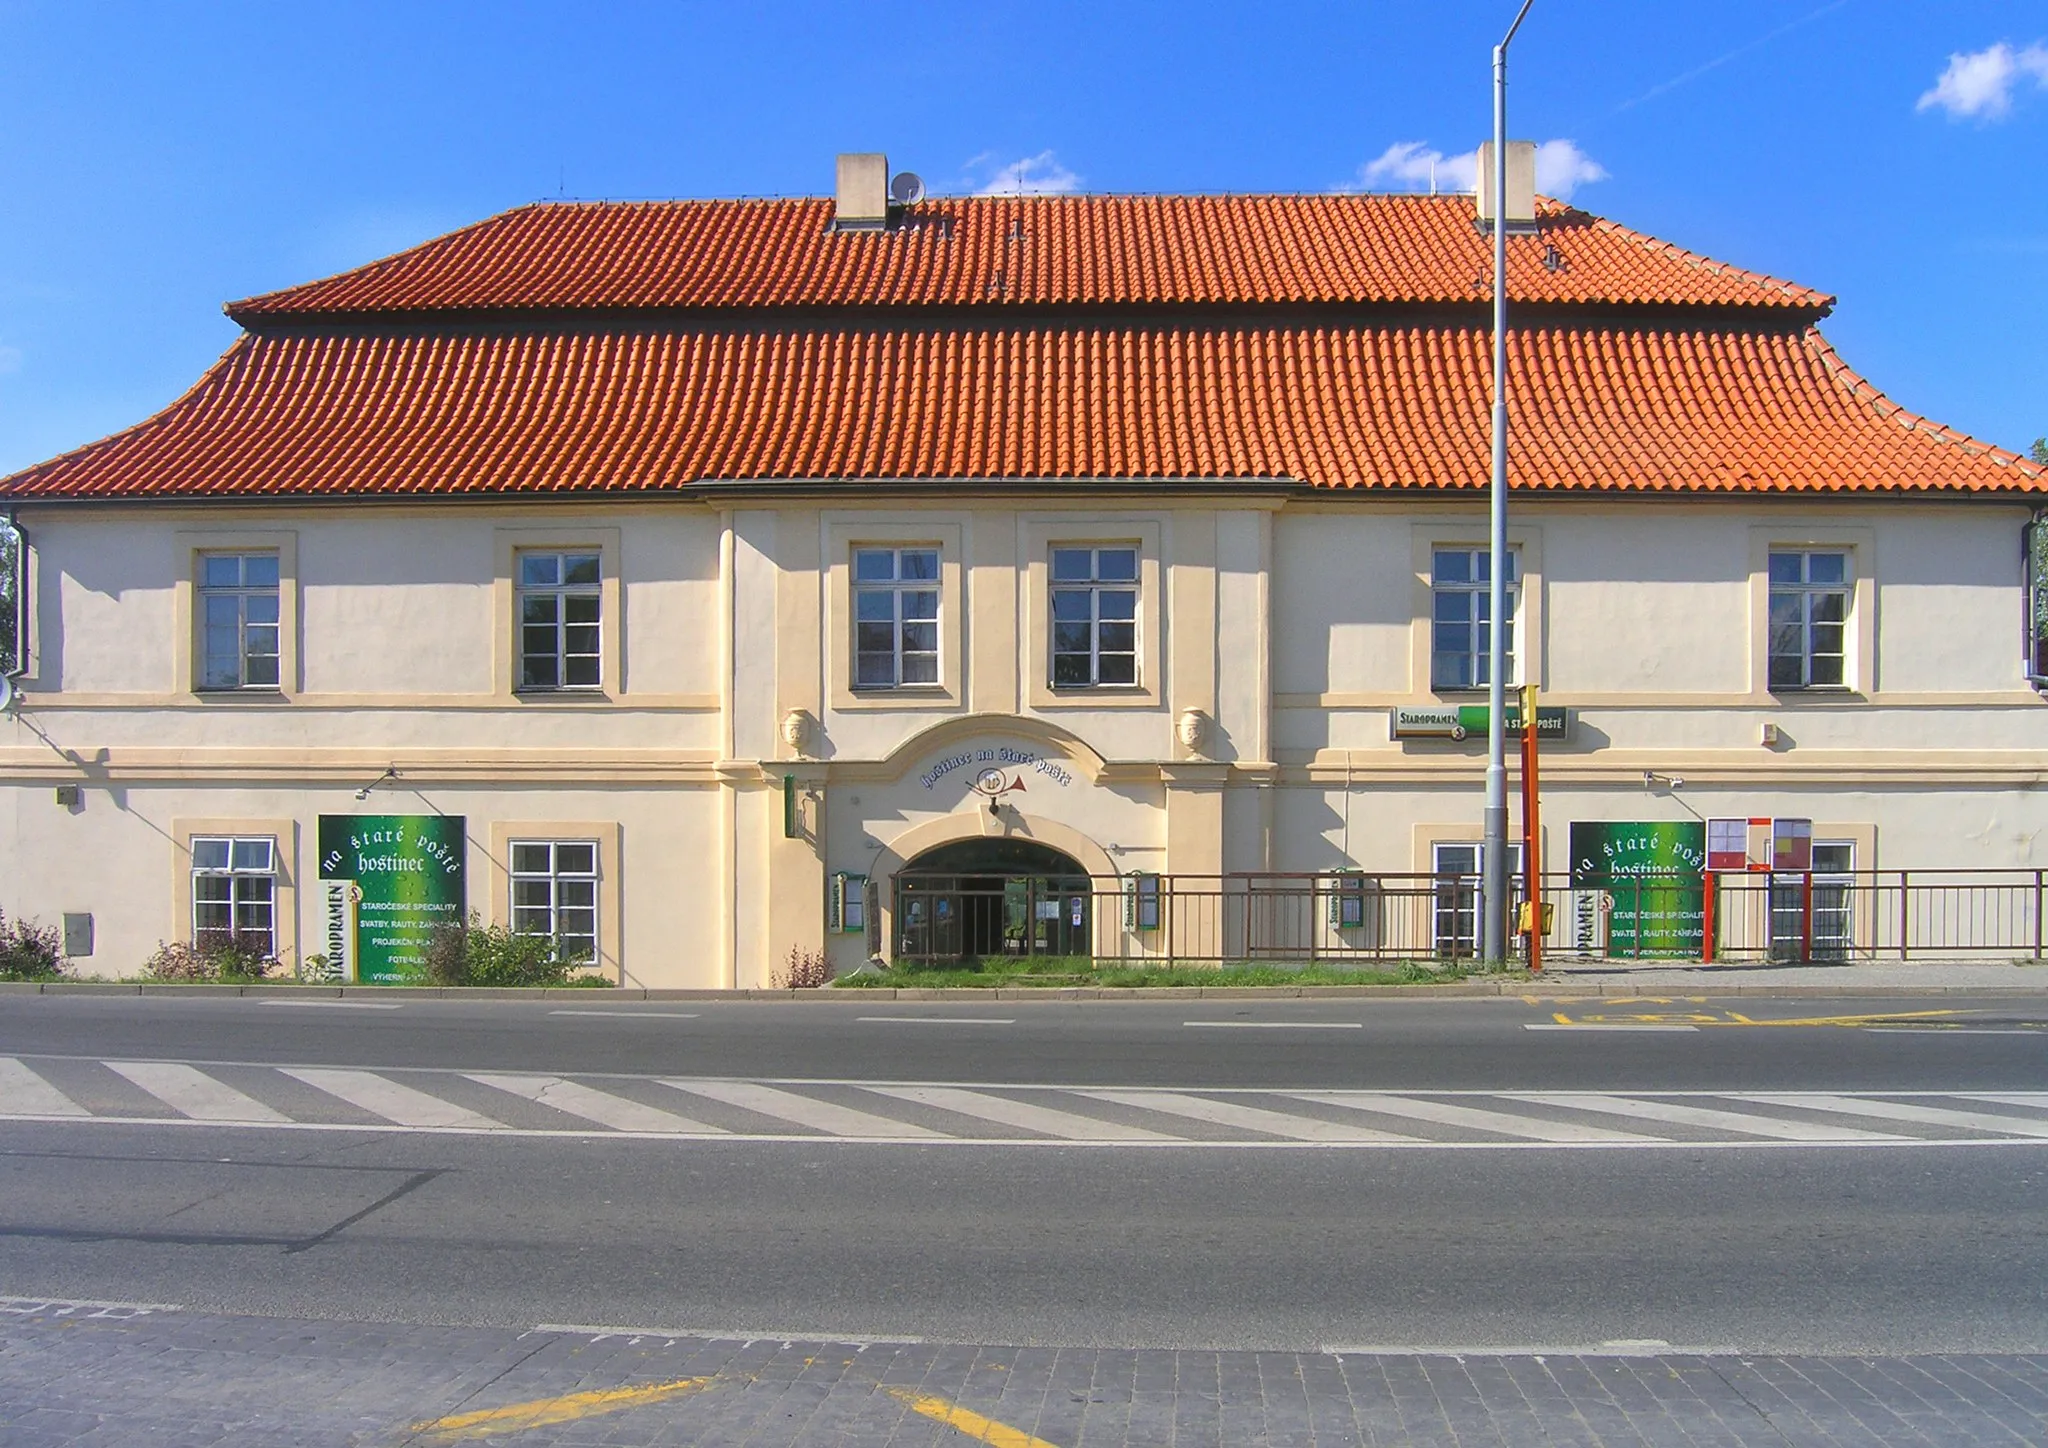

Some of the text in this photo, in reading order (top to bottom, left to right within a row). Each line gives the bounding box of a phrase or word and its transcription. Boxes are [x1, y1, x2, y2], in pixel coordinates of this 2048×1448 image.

[1537, 717, 1562, 729] POŠTĚ
[976, 748, 994, 761] na
[323, 825, 460, 873] na staré poště
[1603, 832, 1660, 857] staré
[358, 852, 424, 875] hostinec
[1610, 860, 1679, 883] hostinec
[362, 902, 457, 911] STAROČESKÉ SPECIALITY
[1613, 911, 1665, 920] STARČESKÉ
[1611, 929, 1642, 938] SVATB,
